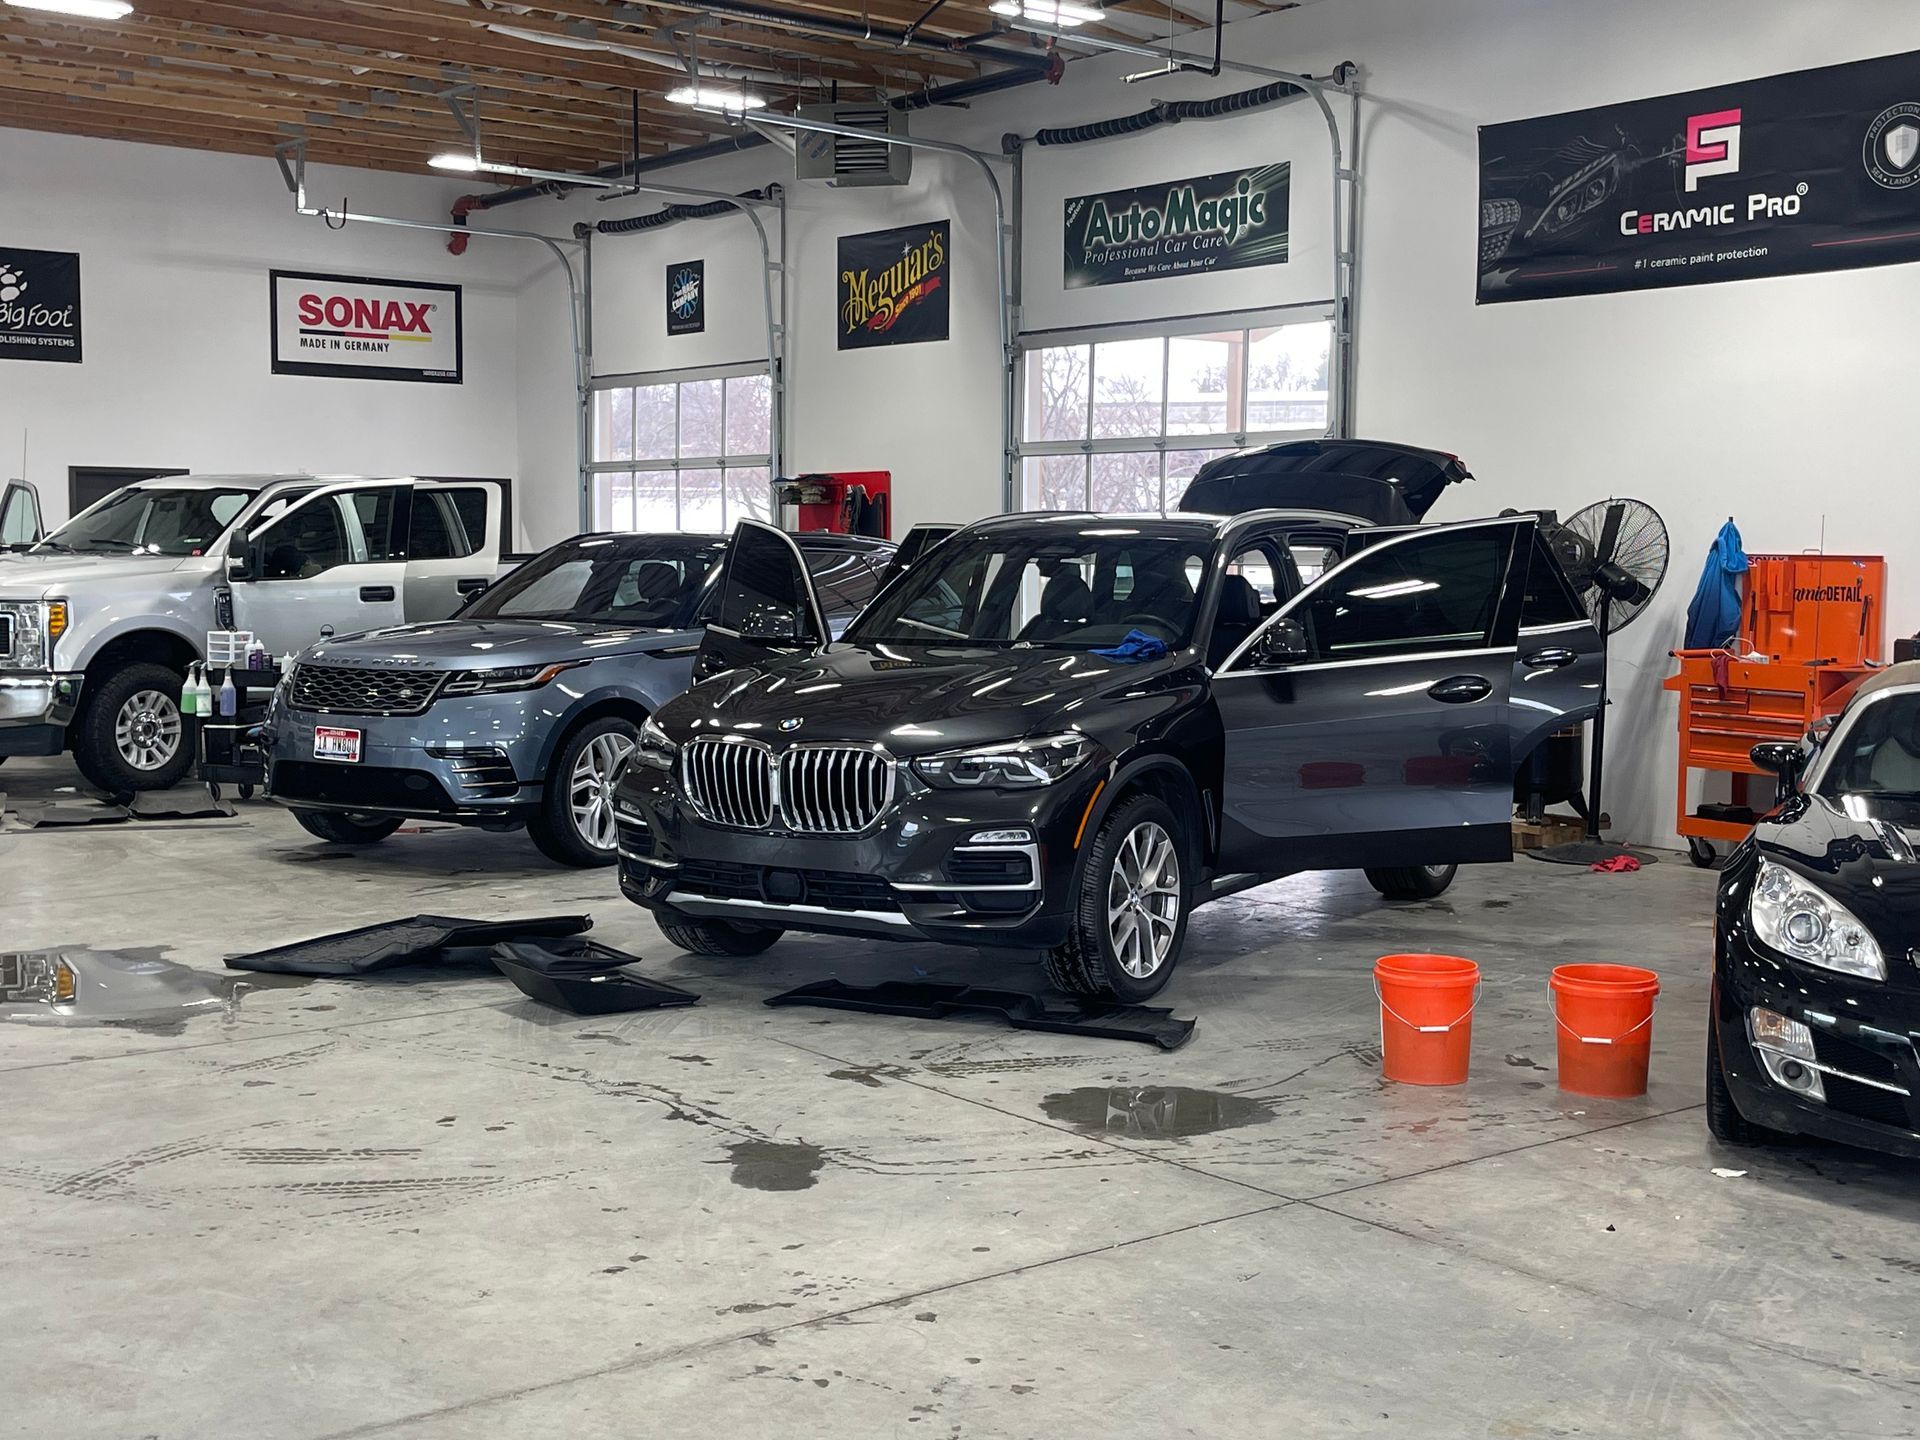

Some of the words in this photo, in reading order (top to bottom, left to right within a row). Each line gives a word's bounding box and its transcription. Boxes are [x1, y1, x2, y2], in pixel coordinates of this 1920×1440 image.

[1871, 166, 1883, 180] SEA
[1889, 176, 1911, 185] LAND
[1620, 204, 1735, 236] CERAMIC
[1084, 241, 1159, 265] Professional
[1164, 240, 1187, 254] Car
[1193, 235, 1223, 250] Care
[1634, 258, 1647, 269] #1
[1650, 255, 1687, 268] ceramic
[1690, 252, 1714, 266] paint
[1717, 246, 1768, 263] protection
[1124, 267, 1147, 276] Because
[1157, 263, 1171, 272] Care
[1171, 261, 1189, 270] About
[1190, 259, 1203, 268] Your
[1204, 257, 1216, 266] Car
[841, 230, 944, 335] Meguiar's
[298, 294, 432, 333] SONAX
[38, 338, 75, 347] SYSTEMS
[300, 338, 326, 349] MADE
[330, 340, 340, 350] IN
[345, 340, 390, 352] GERMANY
